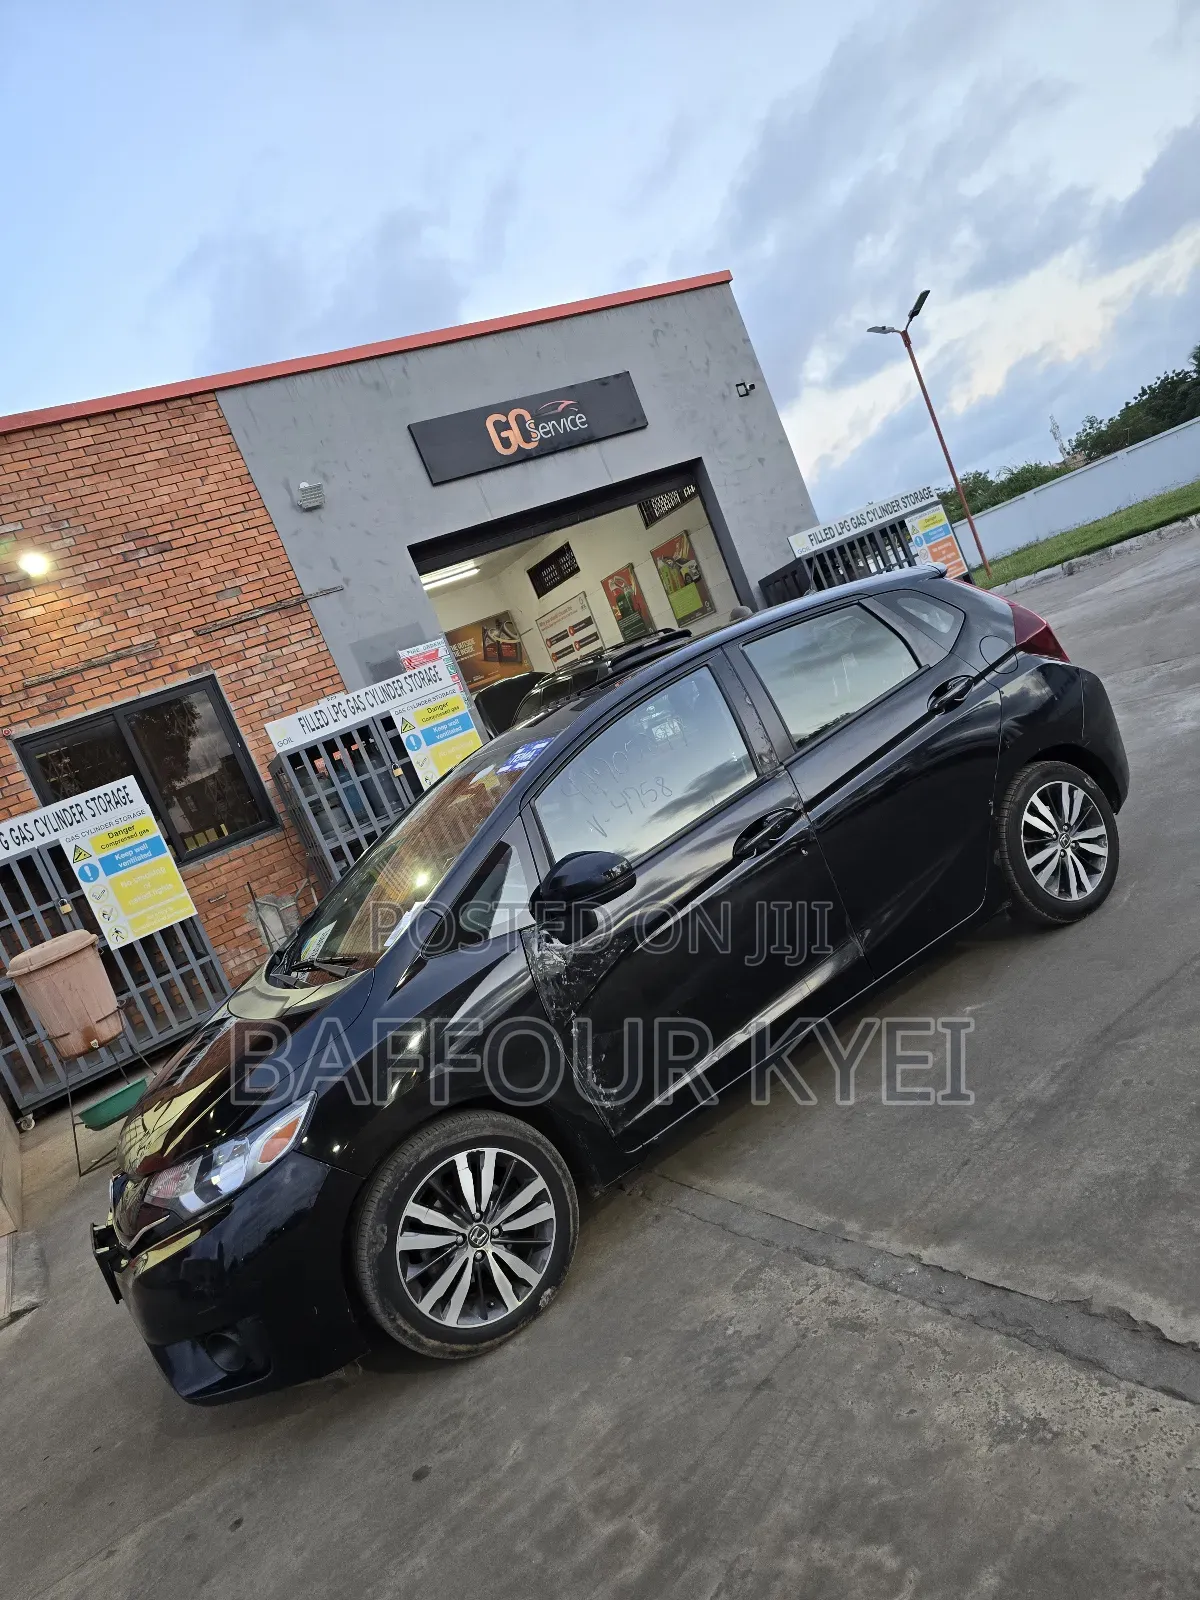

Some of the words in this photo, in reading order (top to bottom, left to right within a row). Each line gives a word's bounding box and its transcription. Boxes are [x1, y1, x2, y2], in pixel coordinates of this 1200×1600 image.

[485, 408, 539, 456] GO
[525, 413, 588, 441] Service
[808, 524, 836, 546] FILLED
[834, 518, 850, 536] LPG
[850, 512, 867, 530] GAS
[866, 500, 902, 522] CYLINDER
[901, 486, 935, 509] STORAGE
[297, 708, 330, 735] FILLED
[328, 700, 348, 728] LPG
[349, 694, 366, 715] GAS
[364, 678, 406, 708] CYLINDER
[404, 665, 442, 692] STORAGE
[426, 702, 448, 714] Danger
[433, 724, 448, 732] Keep
[276, 736, 294, 748] GOIL
[10, 822, 35, 846] GAS
[34, 803, 88, 838] CYLINDER
[86, 785, 134, 818] STORAGE
[65, 833, 81, 844] GAS
[80, 821, 114, 838] CYLINDER
[115, 809, 146, 825] STORAGE
[108, 824, 136, 839] Danger
[100, 833, 138, 850] Compressed
[139, 828, 150, 836] gas
[114, 850, 134, 860] Keep
[134, 842, 149, 852] well
[118, 850, 152, 868] ventilated
